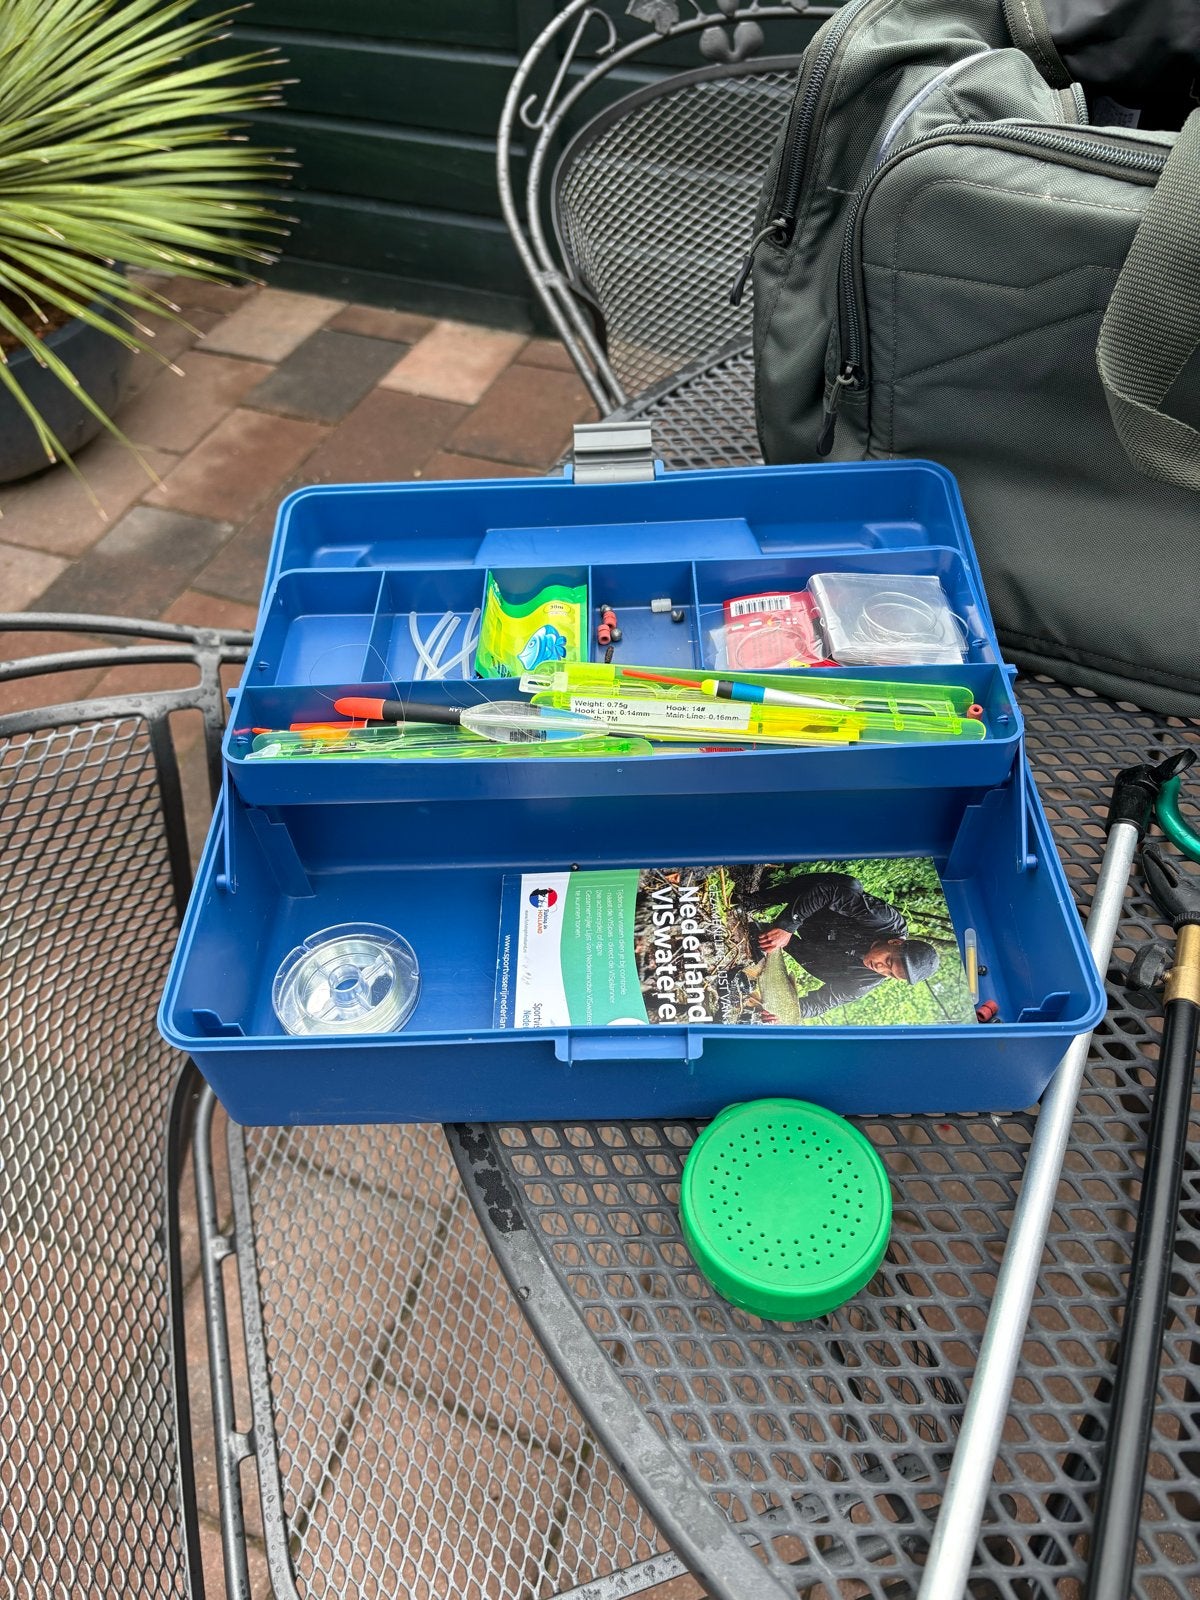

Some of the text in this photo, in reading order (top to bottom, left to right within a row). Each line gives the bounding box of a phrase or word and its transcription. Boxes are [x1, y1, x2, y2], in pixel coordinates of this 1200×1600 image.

[574, 700, 629, 709] Weight: 0.75g
[620, 709, 650, 717] 0.14mm
[686, 712, 706, 720] Line:
[678, 886, 713, 1022] Nederland
[500, 934, 510, 1028] www.sportvisserijnederlan
[717, 965, 730, 991] LIJST
[532, 1003, 543, 1028] Sportvis
